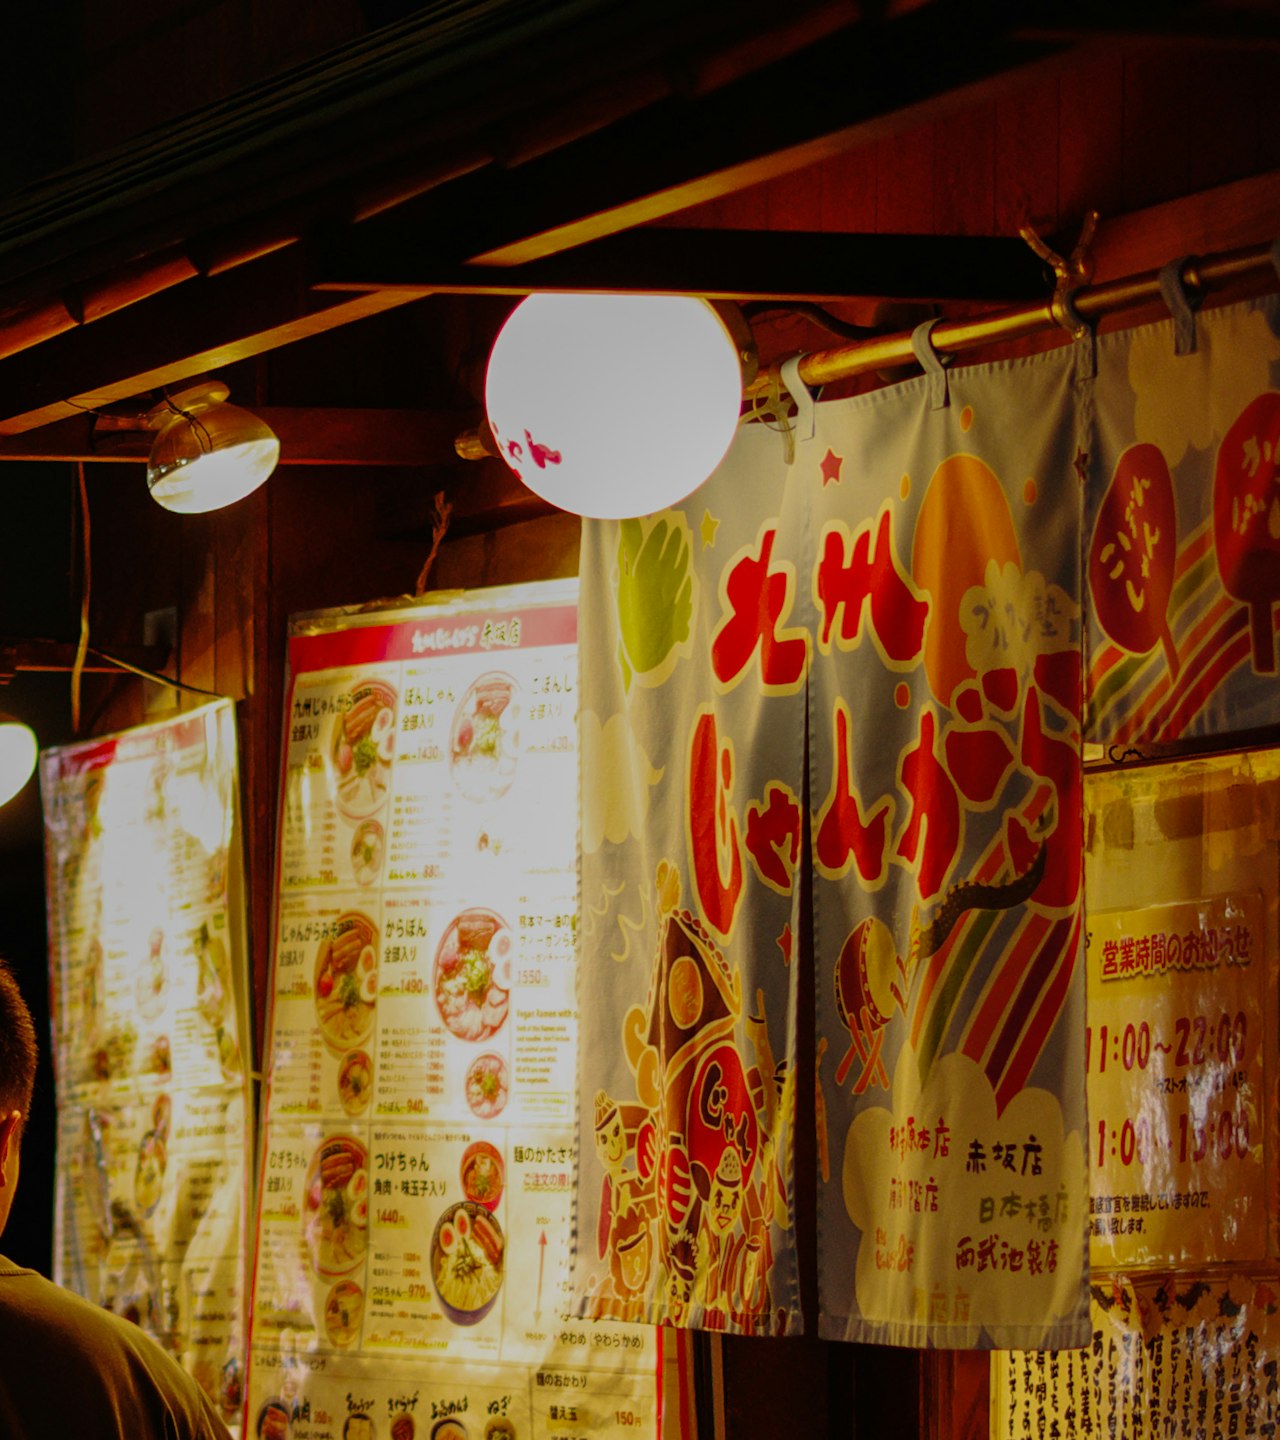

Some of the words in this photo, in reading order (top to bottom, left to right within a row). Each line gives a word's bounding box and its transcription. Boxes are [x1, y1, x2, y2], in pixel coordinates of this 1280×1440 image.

[712, 508, 930, 686] 九州
[480, 617, 521, 650] 赤坂店
[292, 694, 354, 719] 九州じゃんがら
[401, 713, 436, 732] 全部入り
[291, 724, 320, 743] 全部入り
[691, 650, 1082, 934] じゃんがら
[385, 918, 428, 939] からぼん
[279, 950, 305, 968] 全部入り
[384, 947, 417, 964] 全部入り
[1103, 925, 1250, 976] 営業時間のお知らせ
[374, 1152, 430, 1173] つけちゃん
[966, 1133, 1043, 1177] 赤坂店
[267, 1176, 294, 1194] 全部入り
[373, 1179, 448, 1197] 角肉・味玉子入り
[376, 1208, 405, 1225] 1440円
[978, 1182, 1070, 1233] 日本橋店
[955, 1234, 1060, 1277] 西武池袋店
[372, 1285, 403, 1298] つけちゃん
[536, 1372, 588, 1389] 麺のおかわり
[549, 1405, 578, 1422] 替え玉
[614, 1410, 642, 1428] 150円
